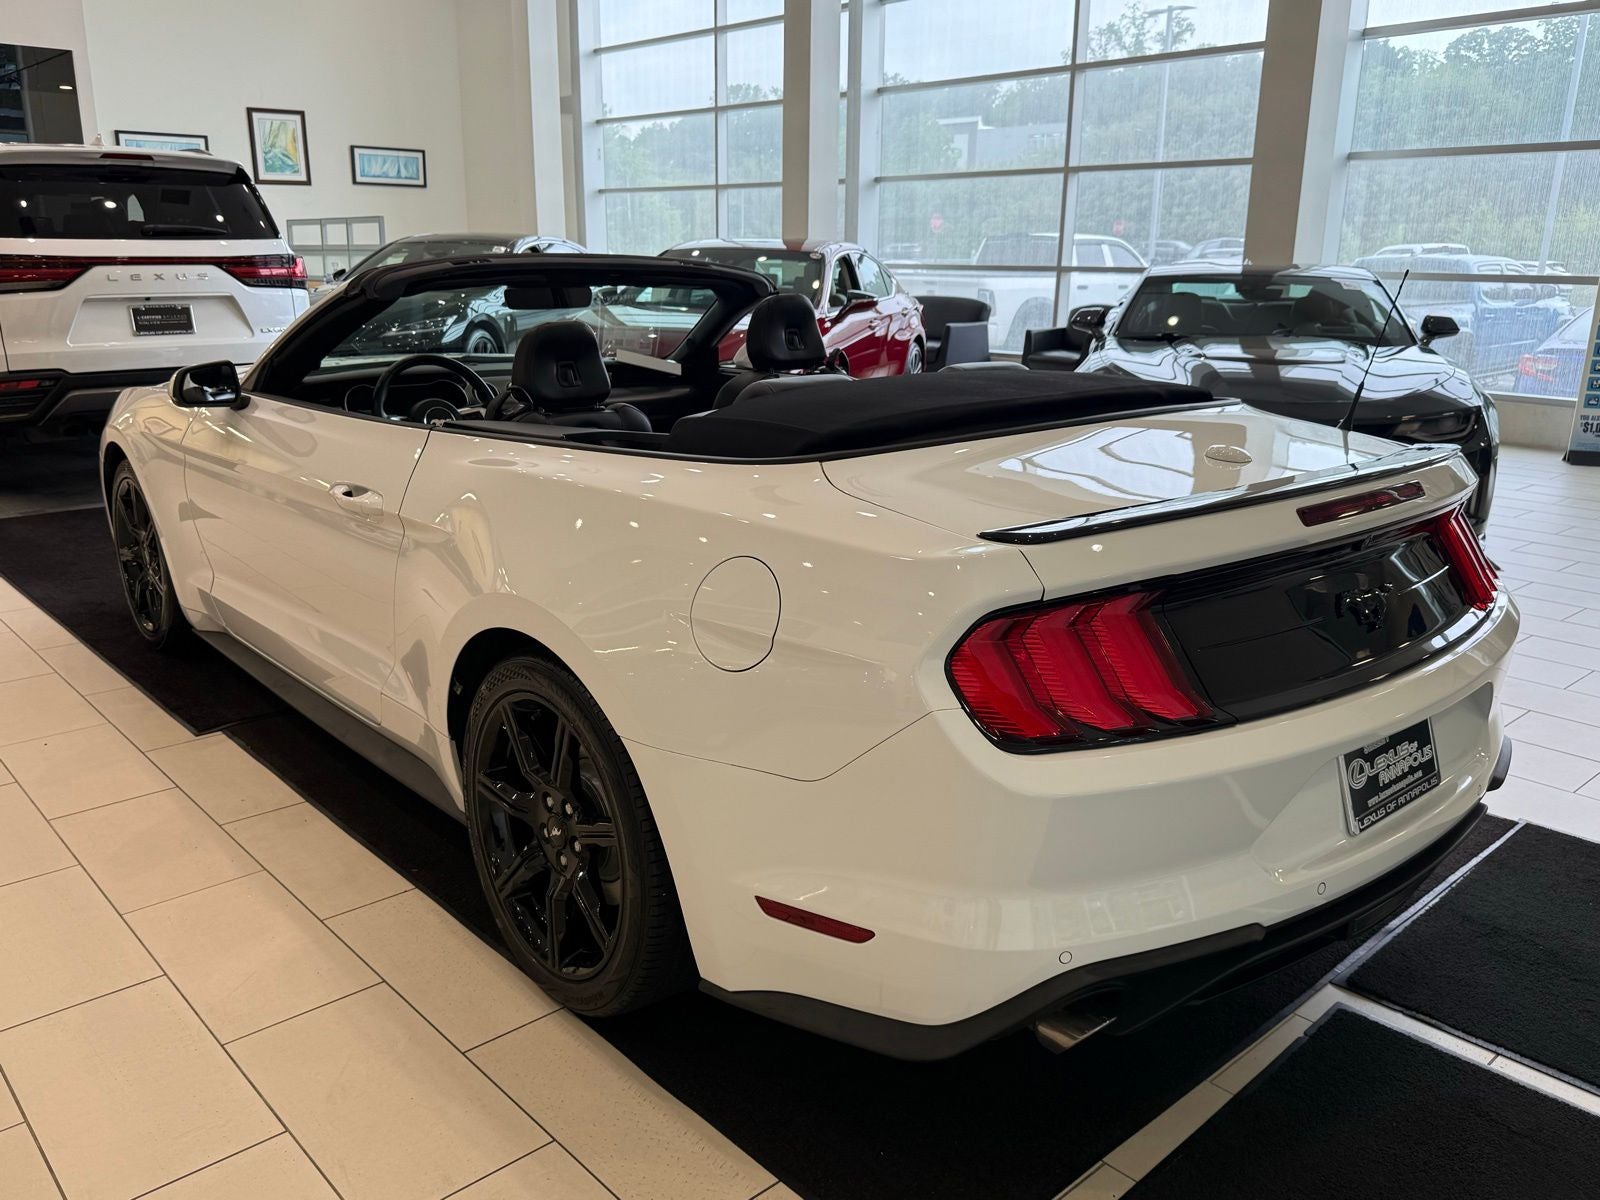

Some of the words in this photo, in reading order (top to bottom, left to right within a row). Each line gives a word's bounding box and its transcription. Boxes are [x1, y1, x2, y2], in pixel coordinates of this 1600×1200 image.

[107, 272, 209, 282] LEXUS
[1366, 741, 1410, 776] LEXUS
[1379, 744, 1433, 786] ANNAPOLIS
[1358, 807, 1386, 829] LEXUS
[1386, 800, 1397, 812] OF
[1398, 776, 1438, 806] ANNAPOLIS
